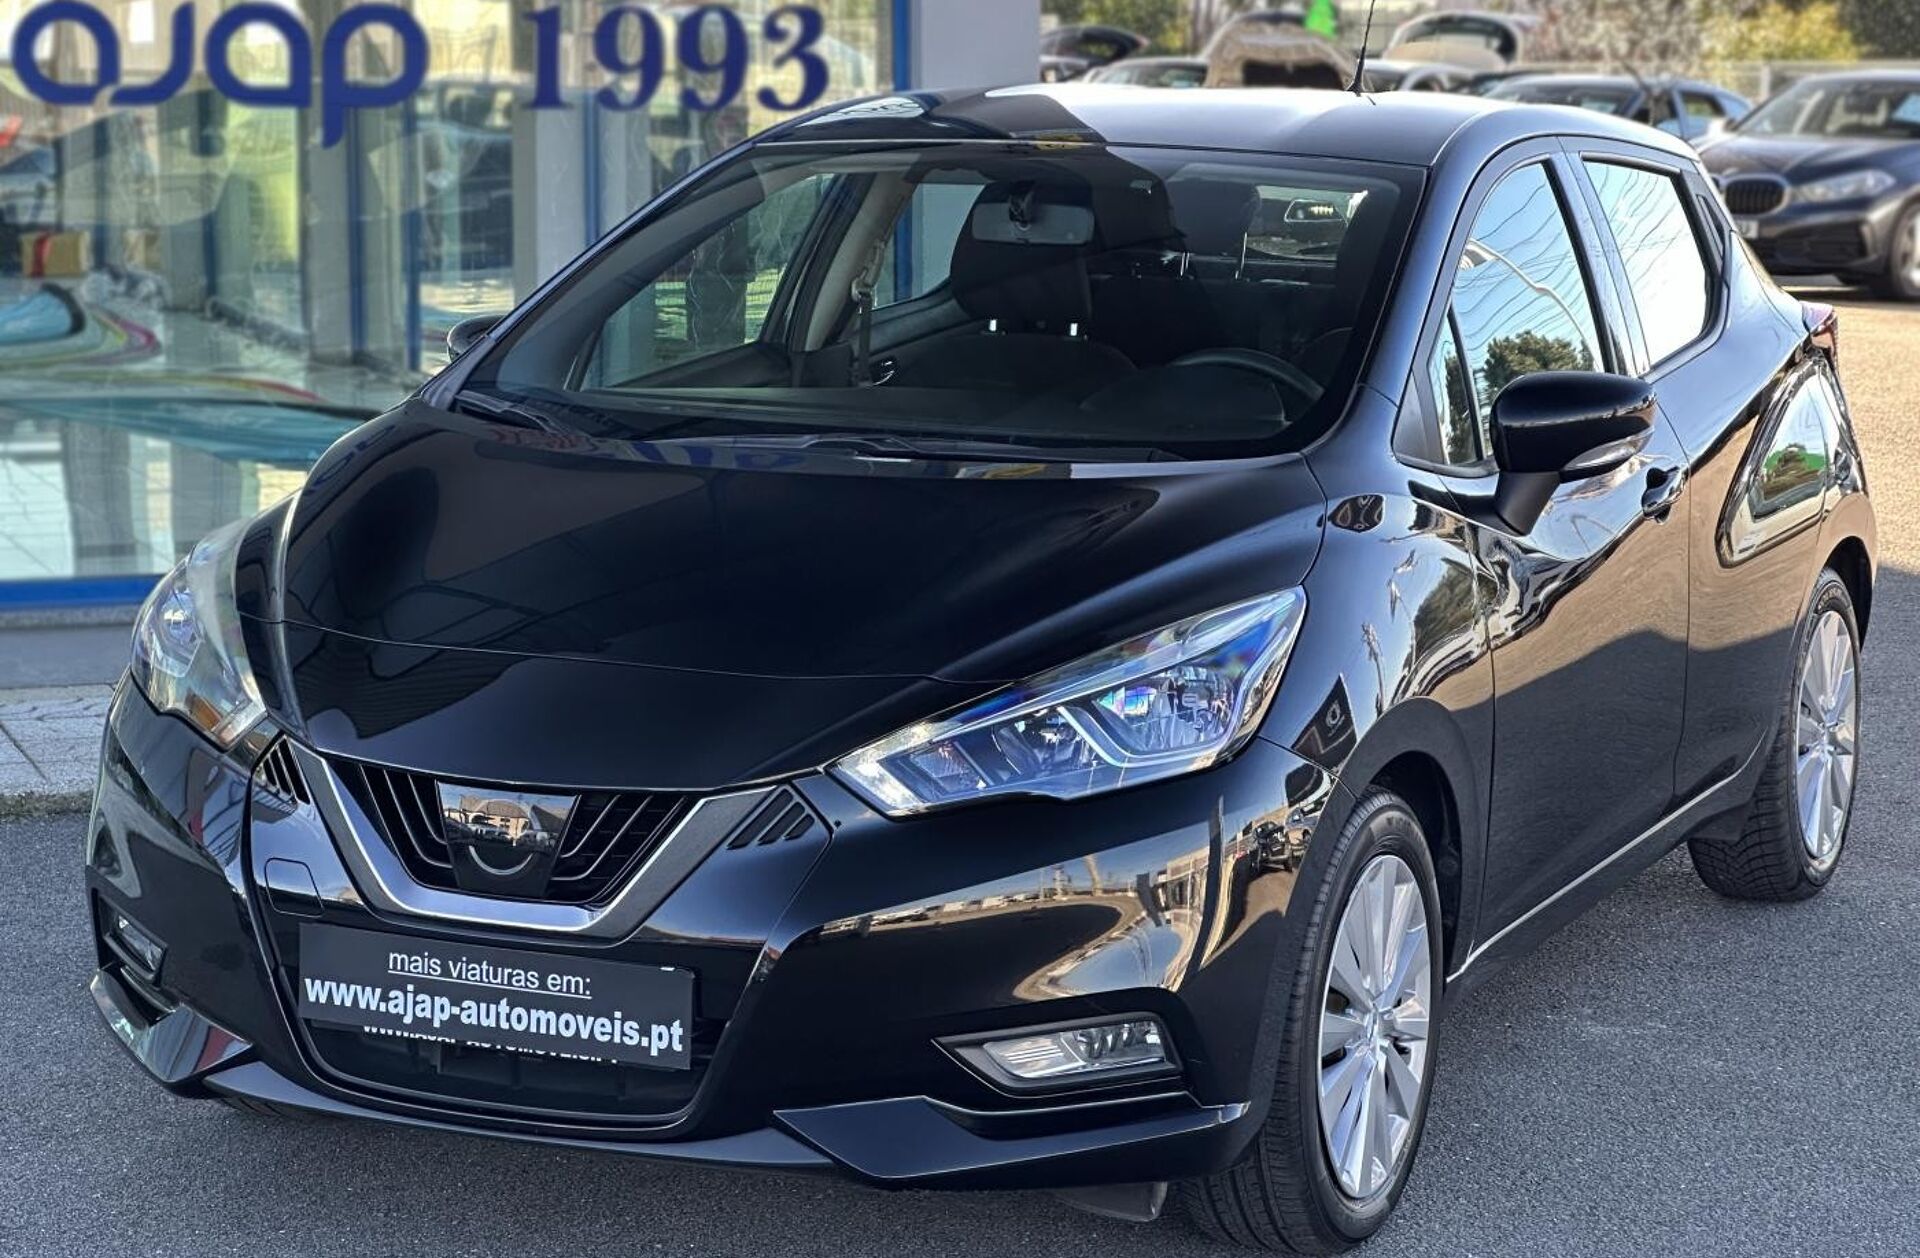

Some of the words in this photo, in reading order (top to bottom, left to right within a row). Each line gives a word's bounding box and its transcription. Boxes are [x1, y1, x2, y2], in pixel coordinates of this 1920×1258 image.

[526, 3, 829, 112] 1993
[388, 951, 442, 976] mais
[448, 957, 540, 989] viaturas
[547, 973, 592, 996] em:
[304, 977, 684, 1056] www.ajap-automoveis.pt
